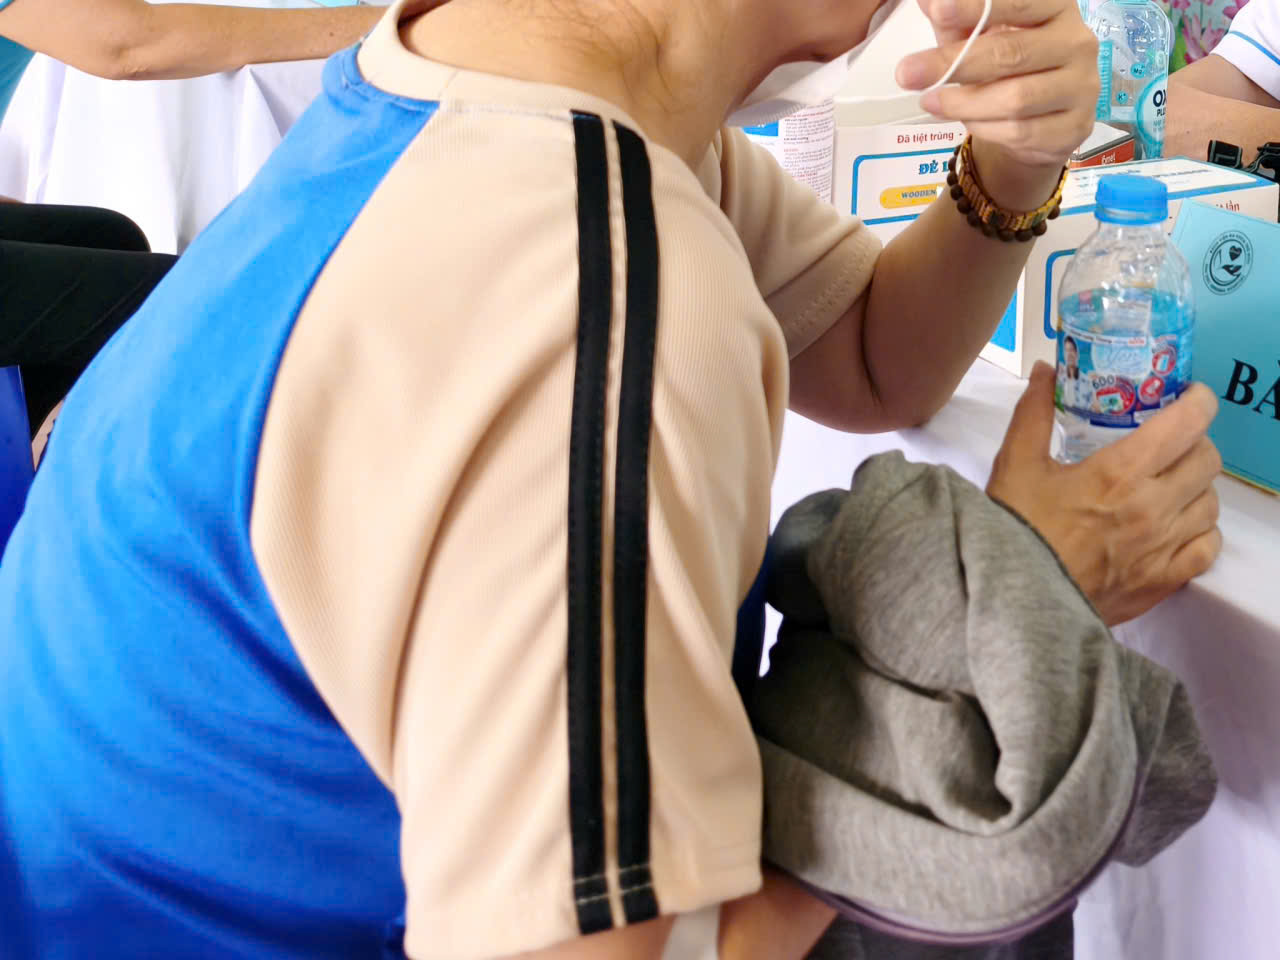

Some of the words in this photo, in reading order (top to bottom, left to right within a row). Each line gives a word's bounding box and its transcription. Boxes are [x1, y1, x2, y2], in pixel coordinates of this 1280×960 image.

[897, 134, 910, 144] Đã
[913, 132, 928, 144] tiệt
[931, 130, 954, 142] trùng
[902, 189, 937, 199] WOODEN
